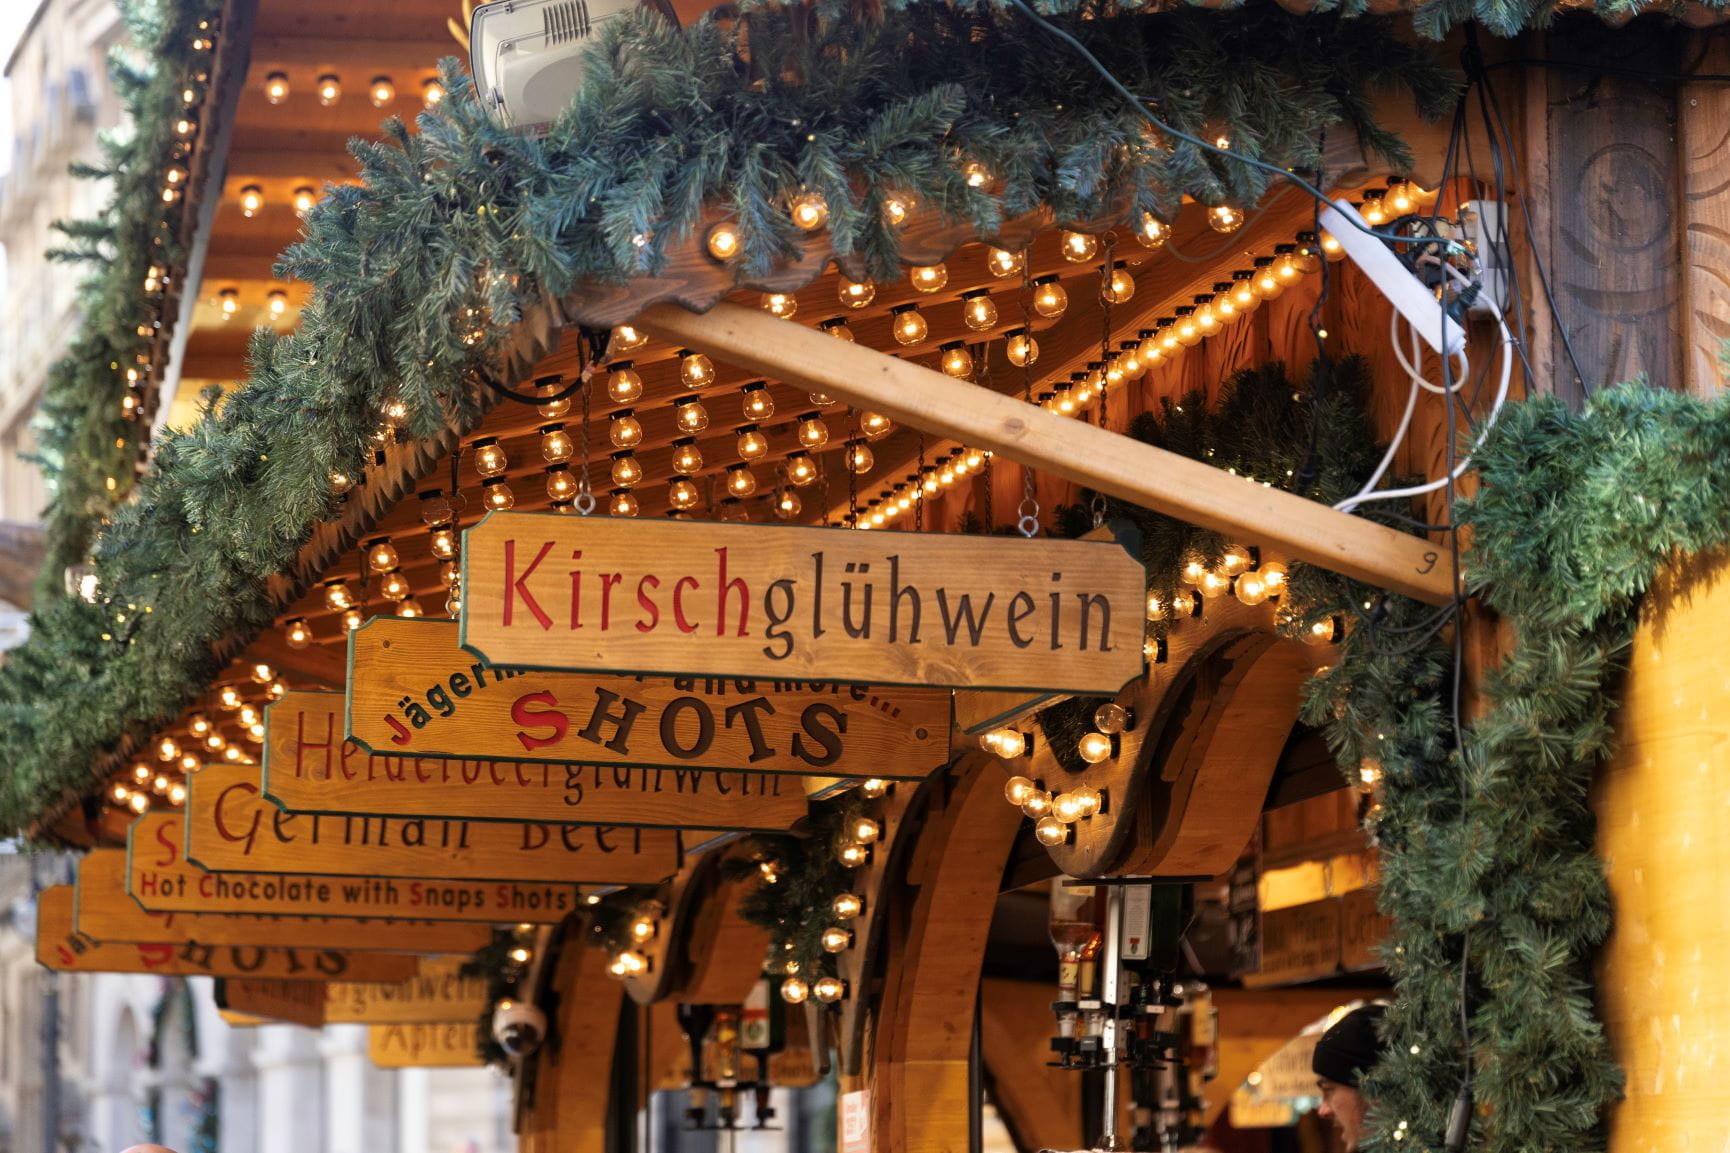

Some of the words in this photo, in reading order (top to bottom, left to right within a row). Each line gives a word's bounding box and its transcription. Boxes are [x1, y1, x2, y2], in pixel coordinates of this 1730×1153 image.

[502, 539, 1114, 660] Kirschglühwein
[510, 686, 848, 767] SHOTS
[140, 873, 187, 898] Hot
[199, 873, 331, 902] Chocolate
[342, 879, 399, 905] with
[409, 882, 485, 912] Snaps
[496, 884, 568, 910] Shots
